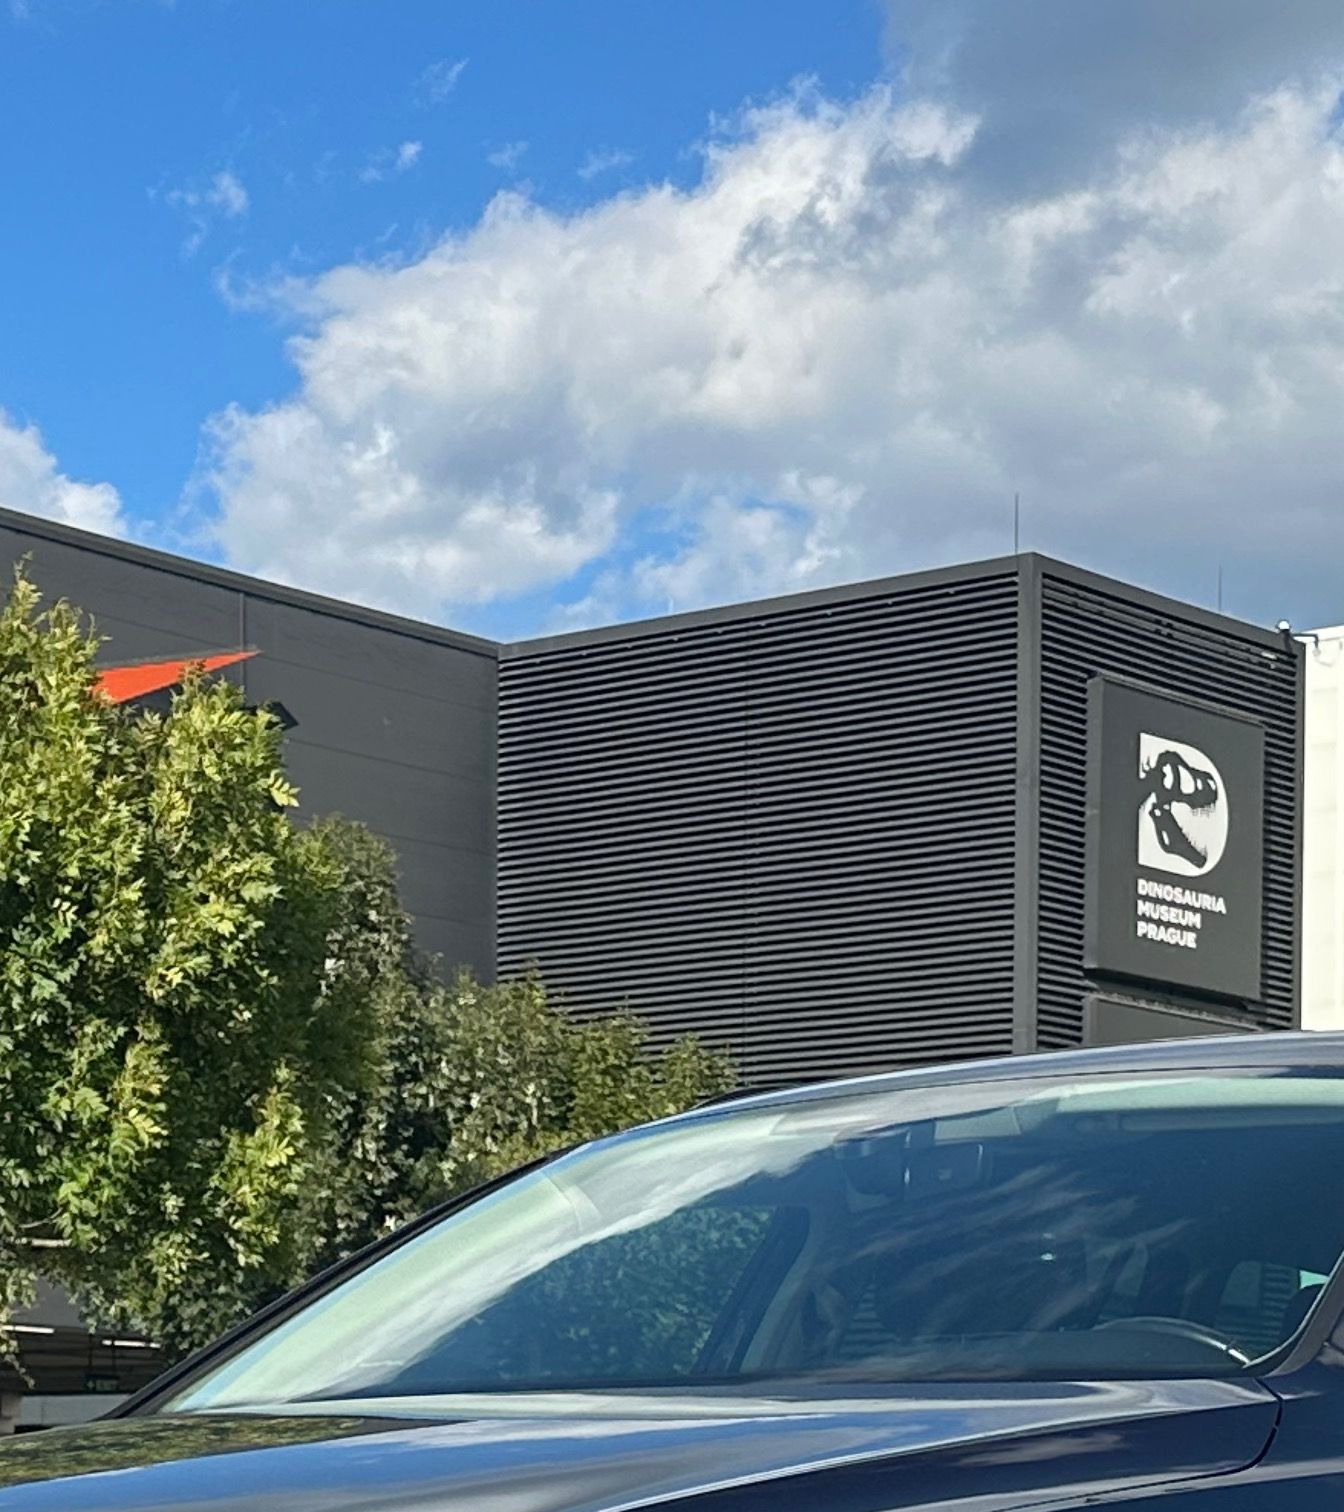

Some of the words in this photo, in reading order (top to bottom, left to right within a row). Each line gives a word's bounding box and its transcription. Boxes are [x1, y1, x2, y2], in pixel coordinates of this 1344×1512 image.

[1136, 878, 1227, 914] DINOSAURIA
[1136, 900, 1201, 929] MUSEUM
[1136, 920, 1197, 949] PRAGUE
